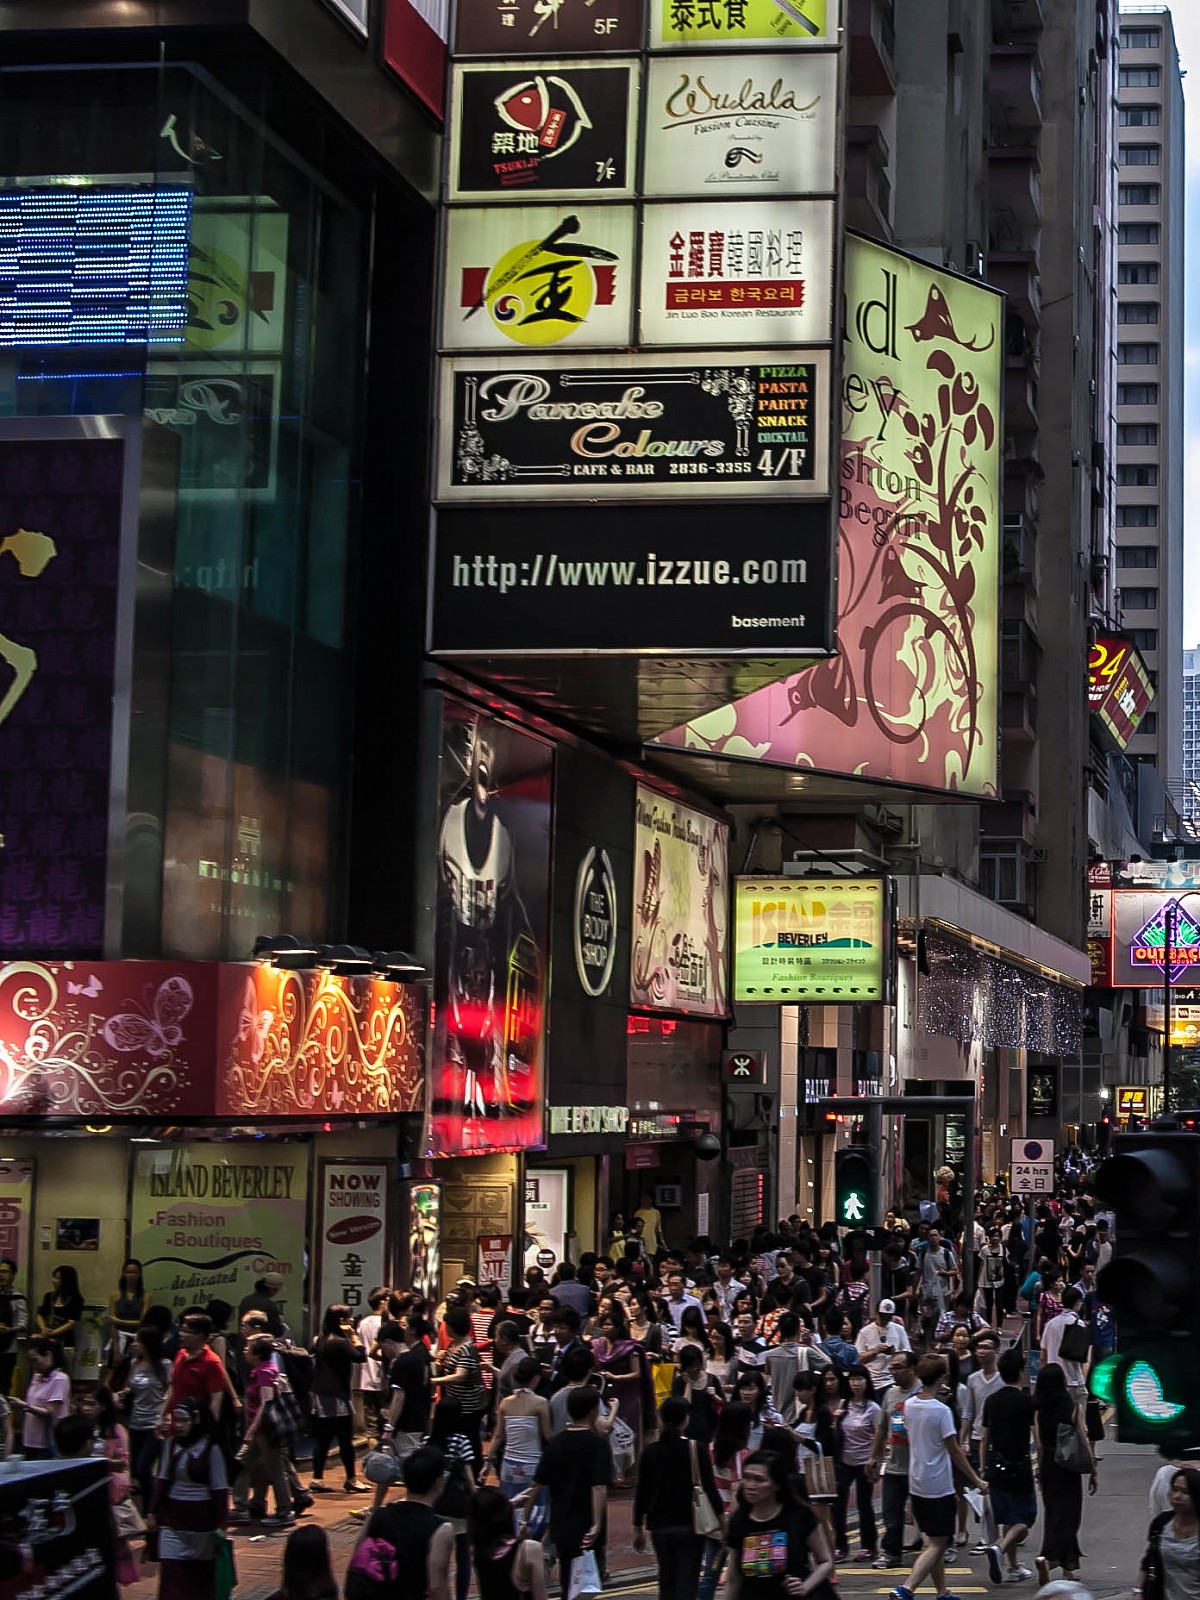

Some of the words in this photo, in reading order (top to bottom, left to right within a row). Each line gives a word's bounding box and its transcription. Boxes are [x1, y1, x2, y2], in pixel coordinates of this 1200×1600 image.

[594, 18, 619, 35] 5F
[721, 309, 753, 318] Korean
[755, 308, 804, 318] Restaurant
[758, 366, 808, 378] PIZZA
[757, 382, 809, 394] PASTA
[479, 373, 664, 422] Pancake
[757, 398, 809, 411] PARTY
[757, 414, 808, 427] SNACK
[571, 421, 726, 458] Colours
[757, 430, 809, 444] COCKTAIL
[573, 464, 608, 476] CAFE
[611, 464, 623, 475] &
[625, 463, 655, 476] BAR
[669, 461, 752, 475] 2836-3355
[756, 448, 806, 477] 4/F
[452, 552, 807, 594] http://www.izzue.com
[731, 613, 806, 629] basement
[777, 932, 828, 946] BEVERLEY
[1015, 1166, 1031, 1176] 24
[1032, 1166, 1049, 1176] hrs
[150, 1163, 209, 1198] ISLAND
[211, 1164, 295, 1200] BEVERLEY
[329, 1174, 382, 1190] NOW
[1018, 1178, 1045, 1191] 全日
[329, 1191, 380, 1208] SHOWING
[156, 1210, 226, 1228] Fashion
[174, 1231, 263, 1251] Boutiques
[481, 1261, 510, 1283] SALE
